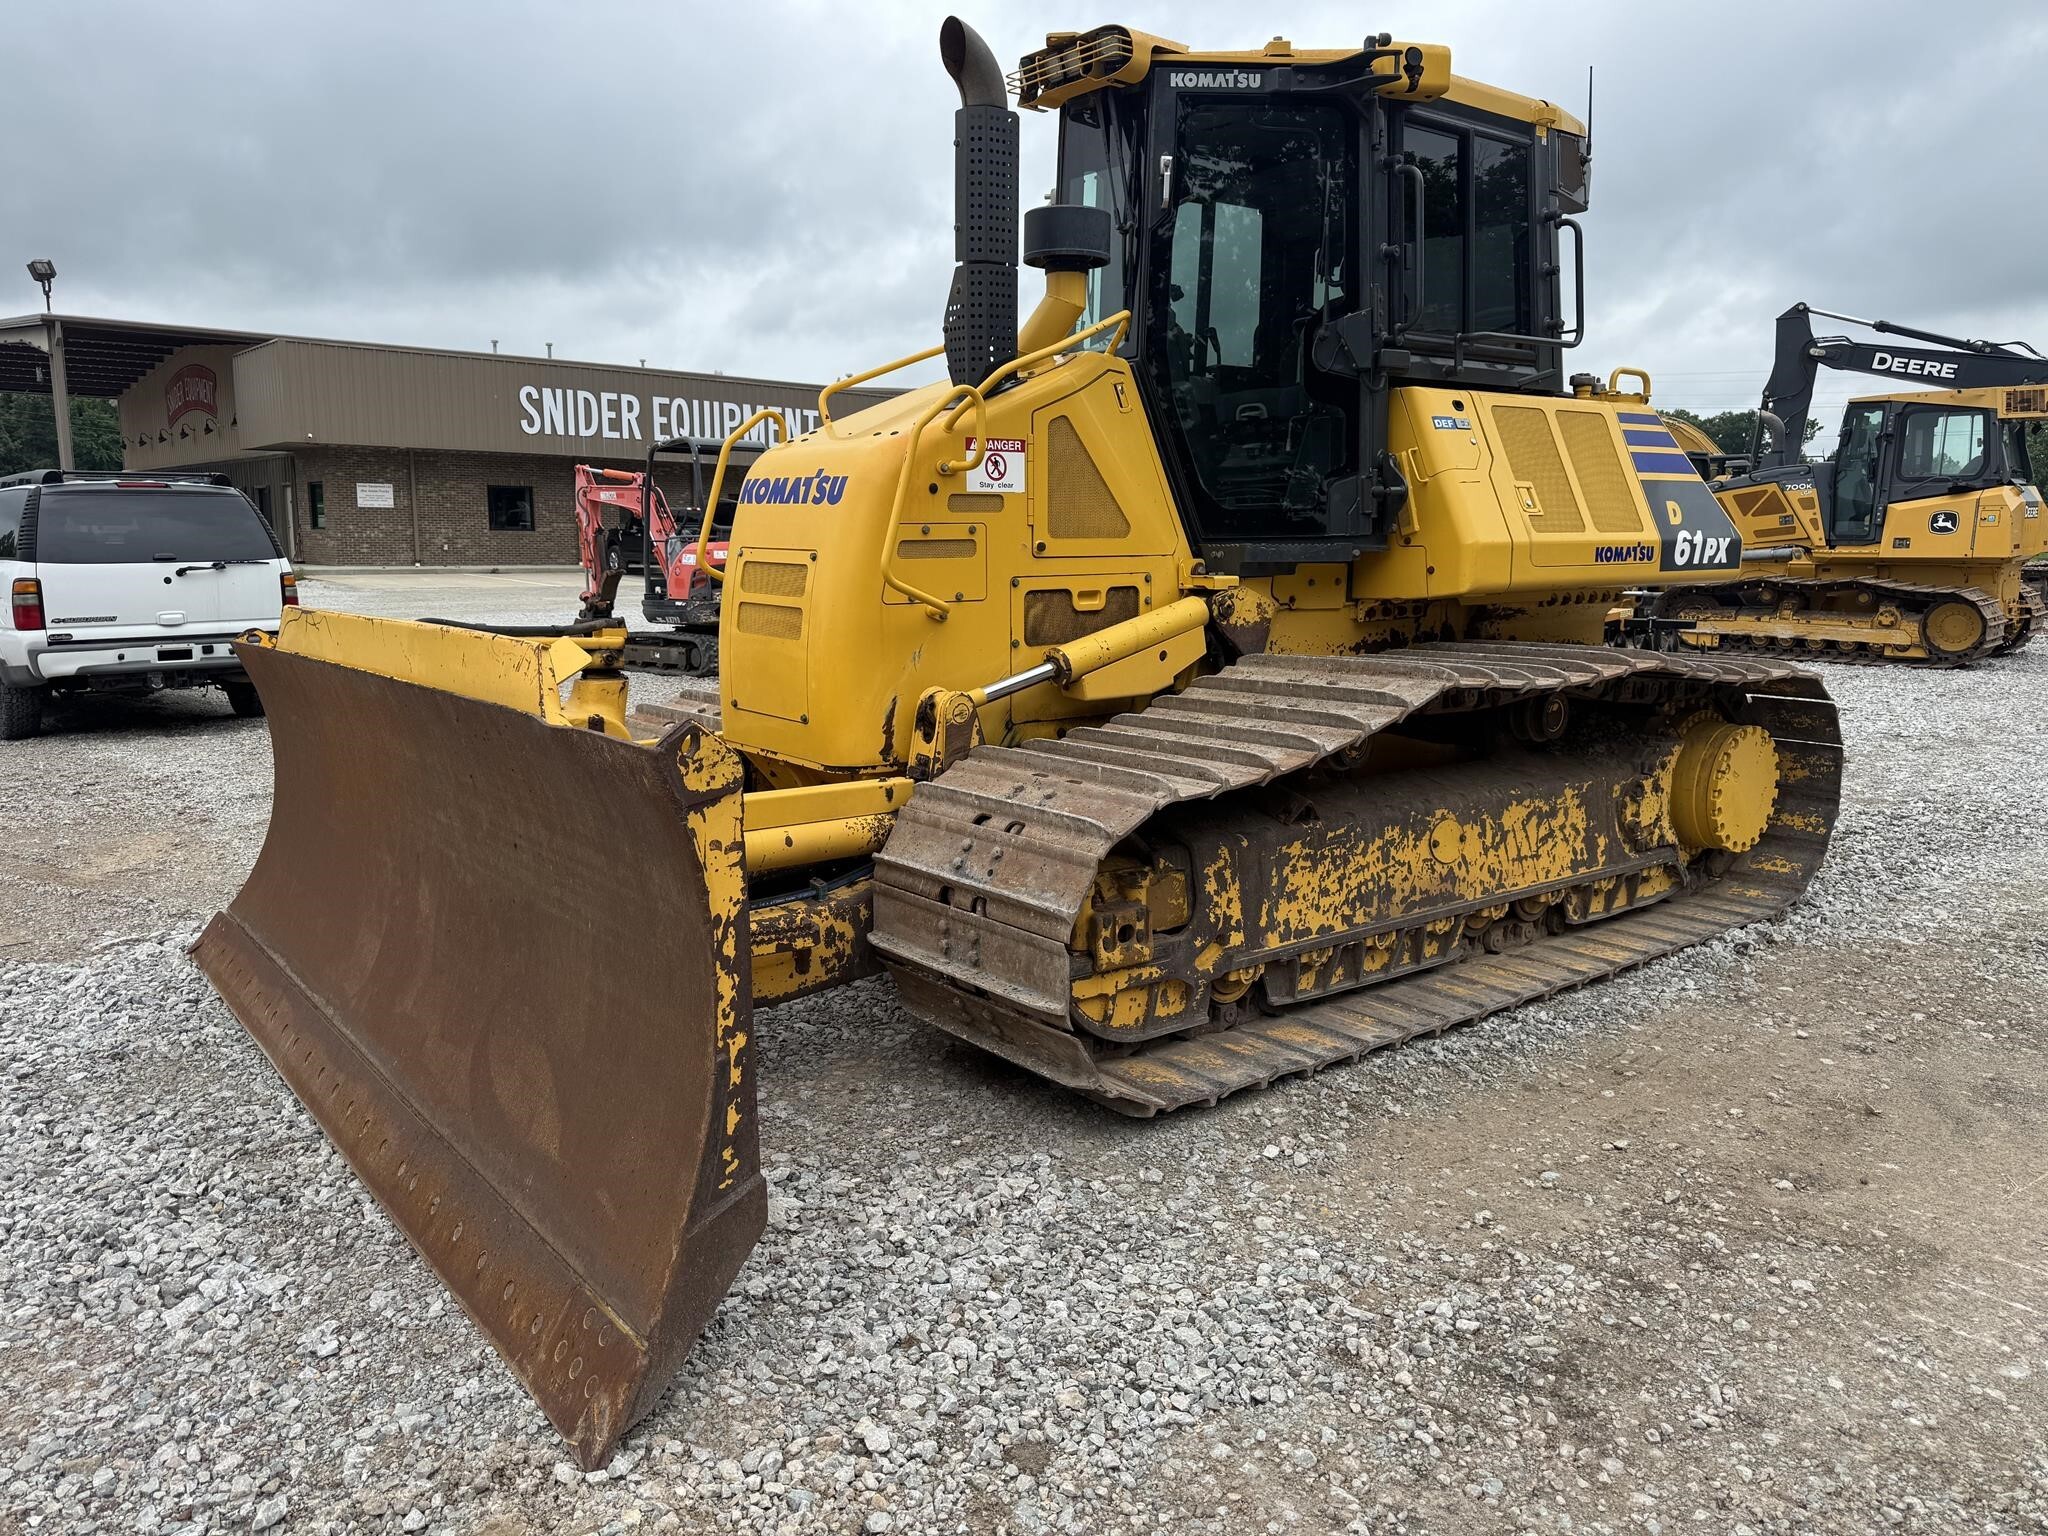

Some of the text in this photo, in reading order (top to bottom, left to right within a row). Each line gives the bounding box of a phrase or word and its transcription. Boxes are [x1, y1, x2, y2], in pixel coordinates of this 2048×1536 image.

[1170, 69, 1261, 88] KOMATSU
[1871, 352, 1959, 379] DEERE
[519, 385, 642, 440] SNIDER
[1433, 419, 1454, 428] DEF
[985, 440, 1022, 451] ANGER
[739, 468, 849, 505] KOMATSU
[979, 481, 995, 490] Stay
[1785, 483, 1812, 491] 700K
[1666, 500, 1683, 525] D
[2025, 505, 2039, 518] DEERE
[1595, 541, 1655, 563] KOMATSU
[1674, 529, 1731, 566] 61PX
